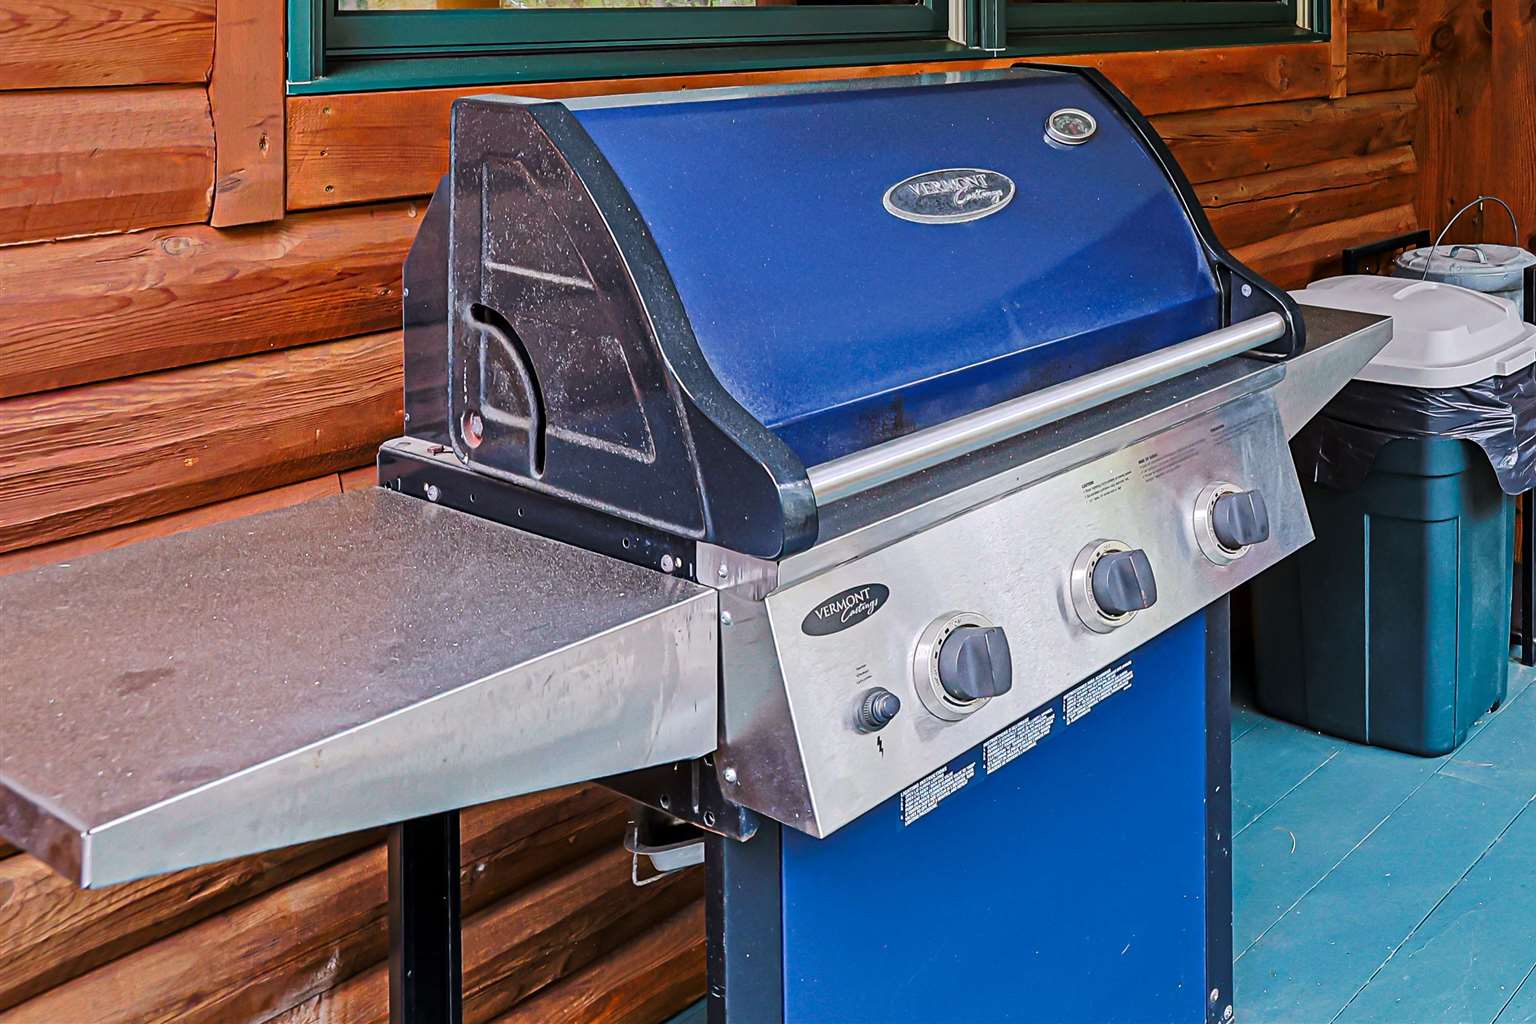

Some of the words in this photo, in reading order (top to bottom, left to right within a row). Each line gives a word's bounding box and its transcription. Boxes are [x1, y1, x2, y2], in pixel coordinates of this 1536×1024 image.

[908, 174, 988, 196] VERMONT
[814, 587, 870, 619] VERMONT
[840, 598, 879, 623] Castings
